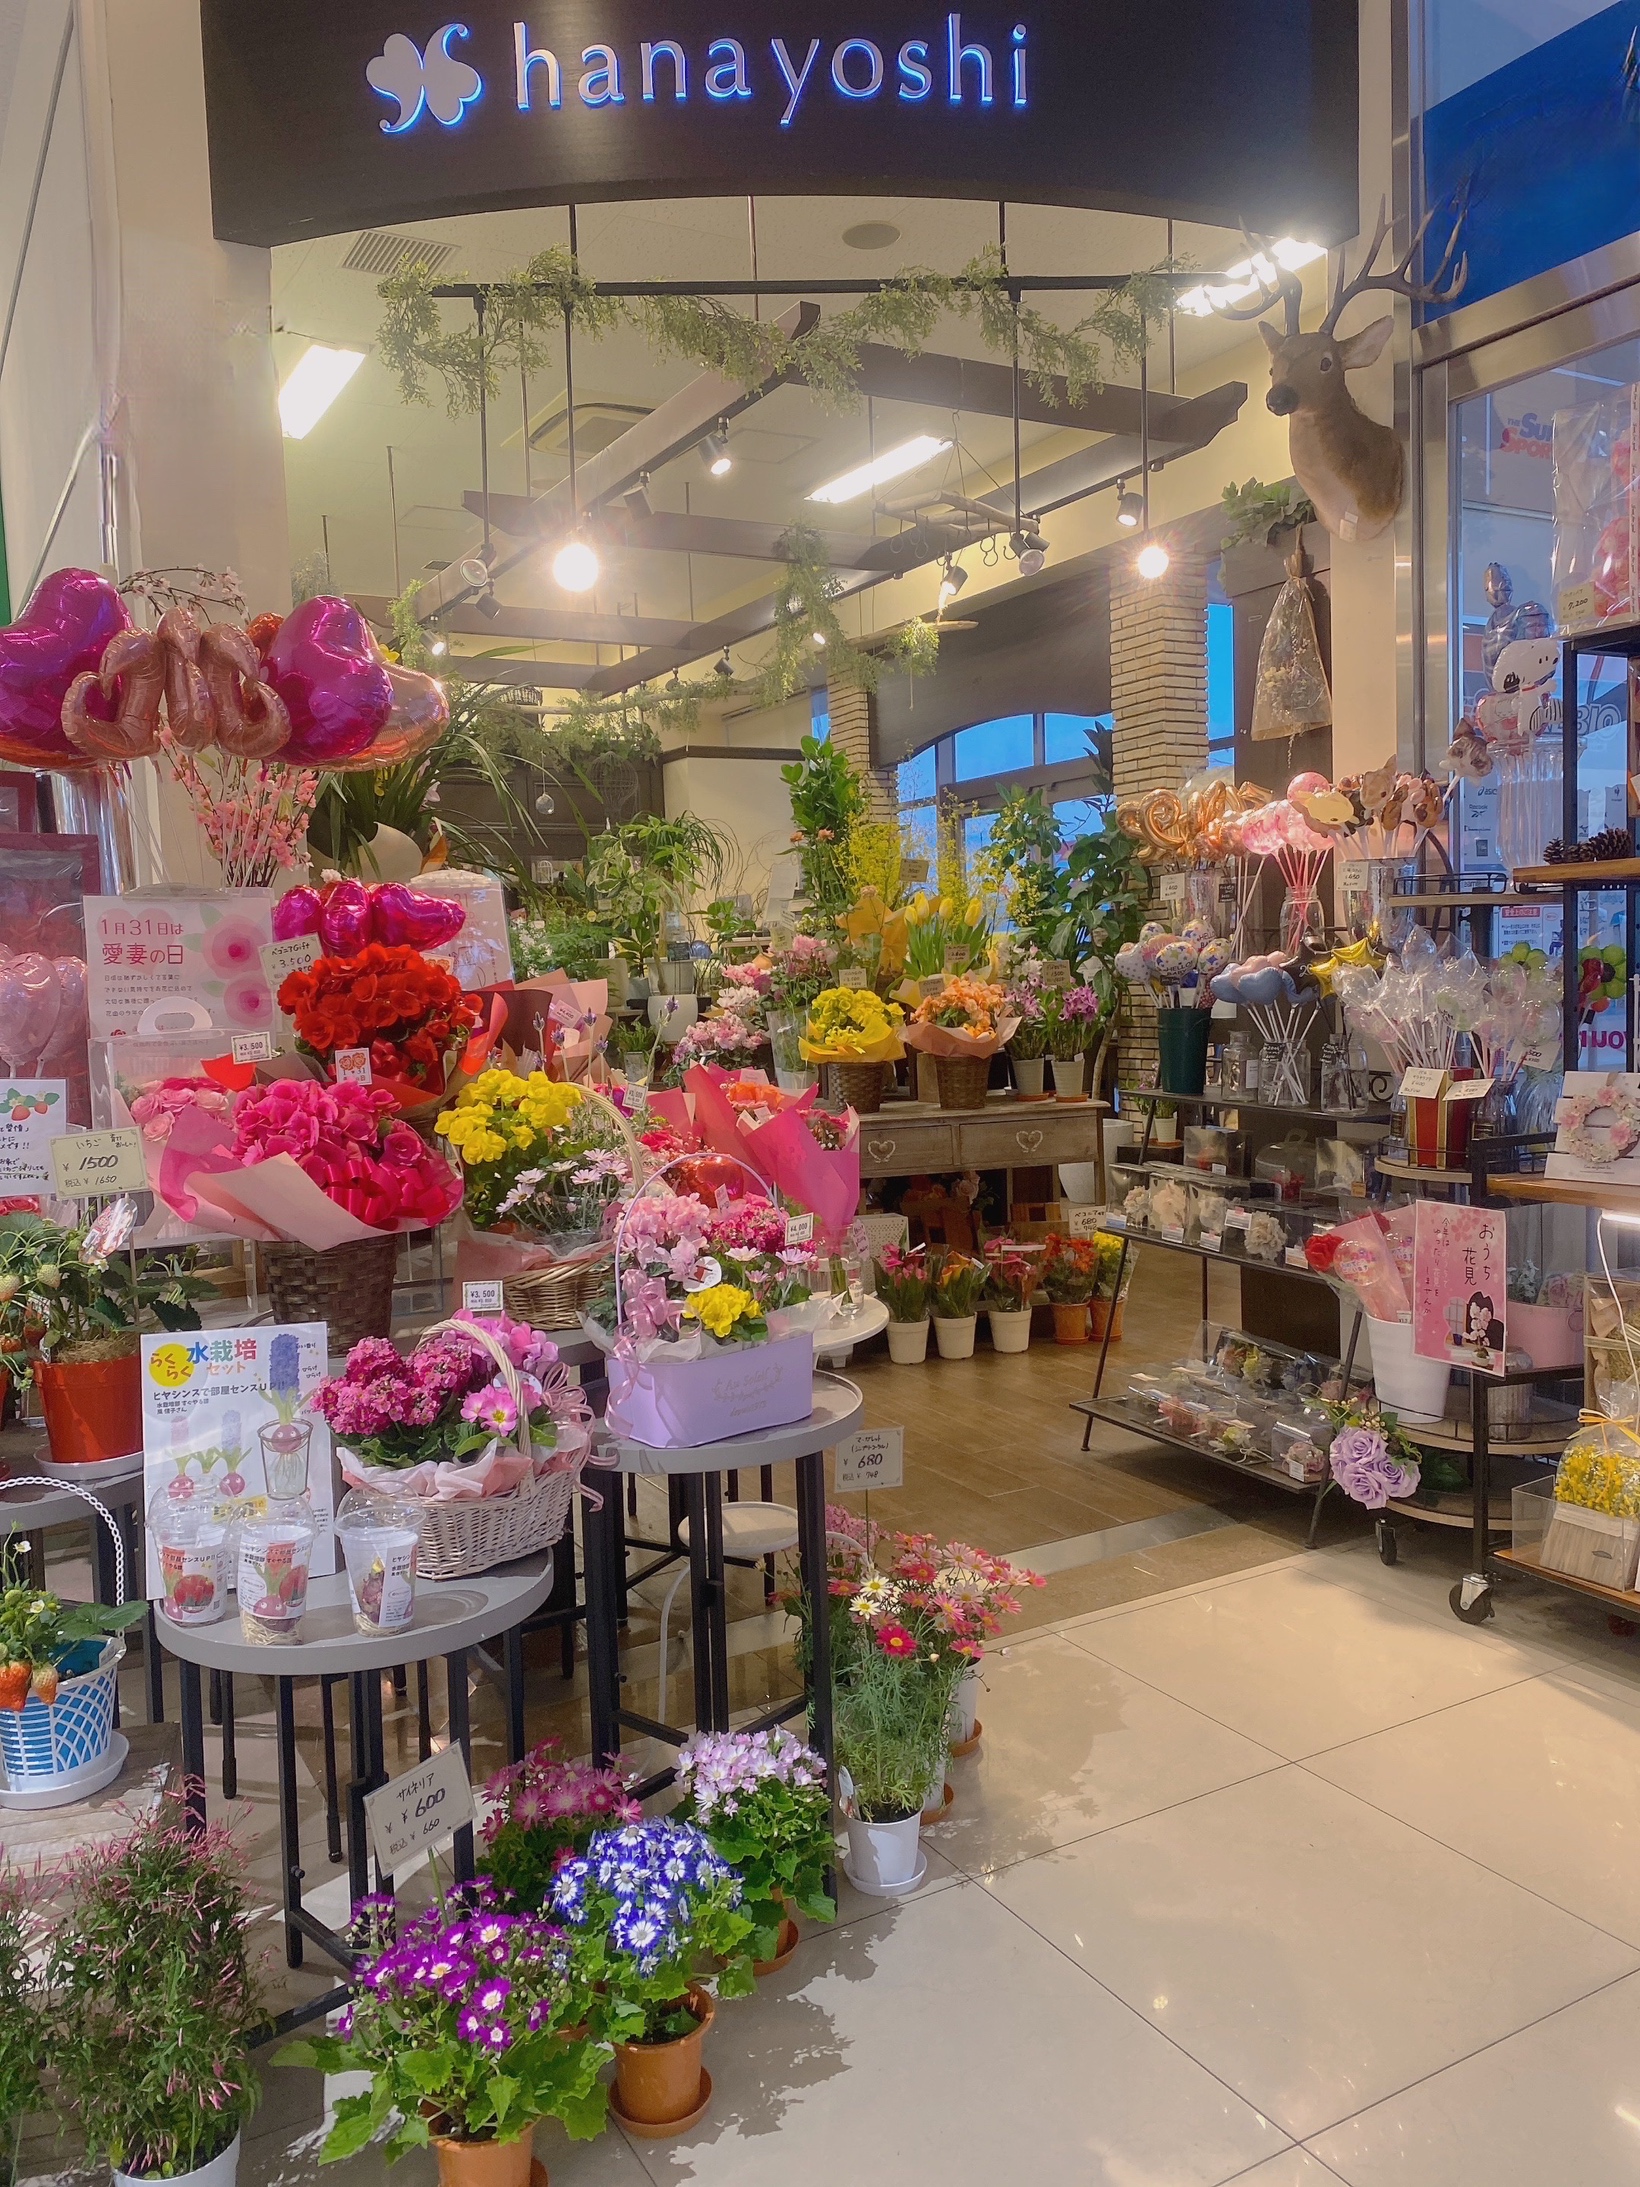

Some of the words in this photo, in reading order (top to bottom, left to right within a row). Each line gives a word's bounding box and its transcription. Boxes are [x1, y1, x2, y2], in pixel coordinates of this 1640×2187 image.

[512, 12, 1030, 125] hanayoshi
[101, 918, 185, 936] 1月31日は
[102, 942, 184, 965] 愛妻の日
[76, 1139, 101, 1150] いちご
[79, 1154, 119, 1171] 1500
[95, 1175, 117, 1185] 1650
[1081, 1217, 1098, 1226] 680
[1478, 1223, 1495, 1281] おうち
[1462, 1246, 1477, 1286] 花見
[186, 1337, 257, 1364] 水栽培
[150, 1352, 176, 1368] らく
[206, 1361, 246, 1376] セット
[166, 1365, 192, 1380] らく
[858, 1453, 883, 1469] 680
[396, 1772, 435, 1802] サイネリア
[414, 1787, 446, 1818] 600
[422, 1817, 440, 1835] 660
